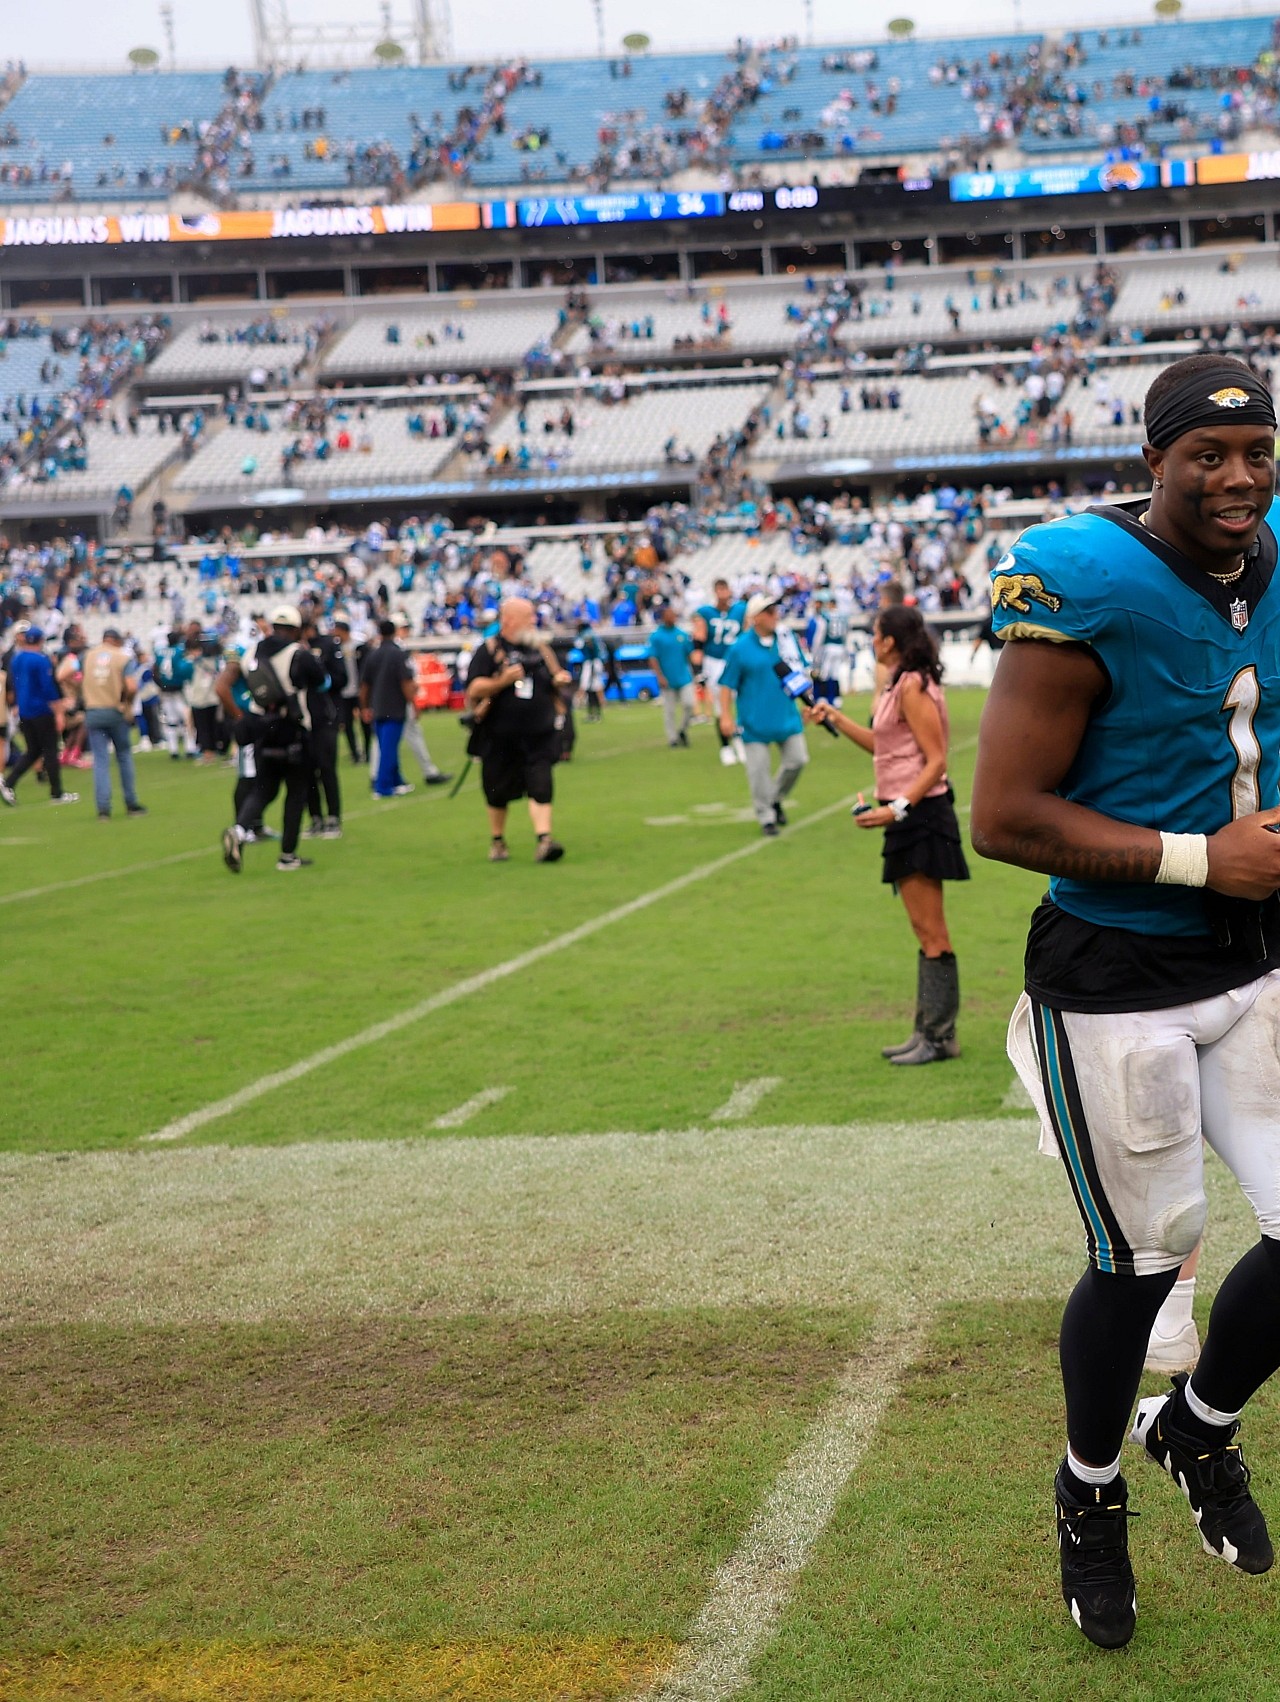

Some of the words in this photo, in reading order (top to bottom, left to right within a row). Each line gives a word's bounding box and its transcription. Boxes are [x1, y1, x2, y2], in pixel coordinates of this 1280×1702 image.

[3, 215, 109, 245] JAGUARS
[117, 214, 171, 242] WIN
[271, 207, 375, 237] JAGUARS
[380, 204, 434, 233] WIN
[708, 616, 742, 647] 72
[1218, 664, 1261, 822] 1
